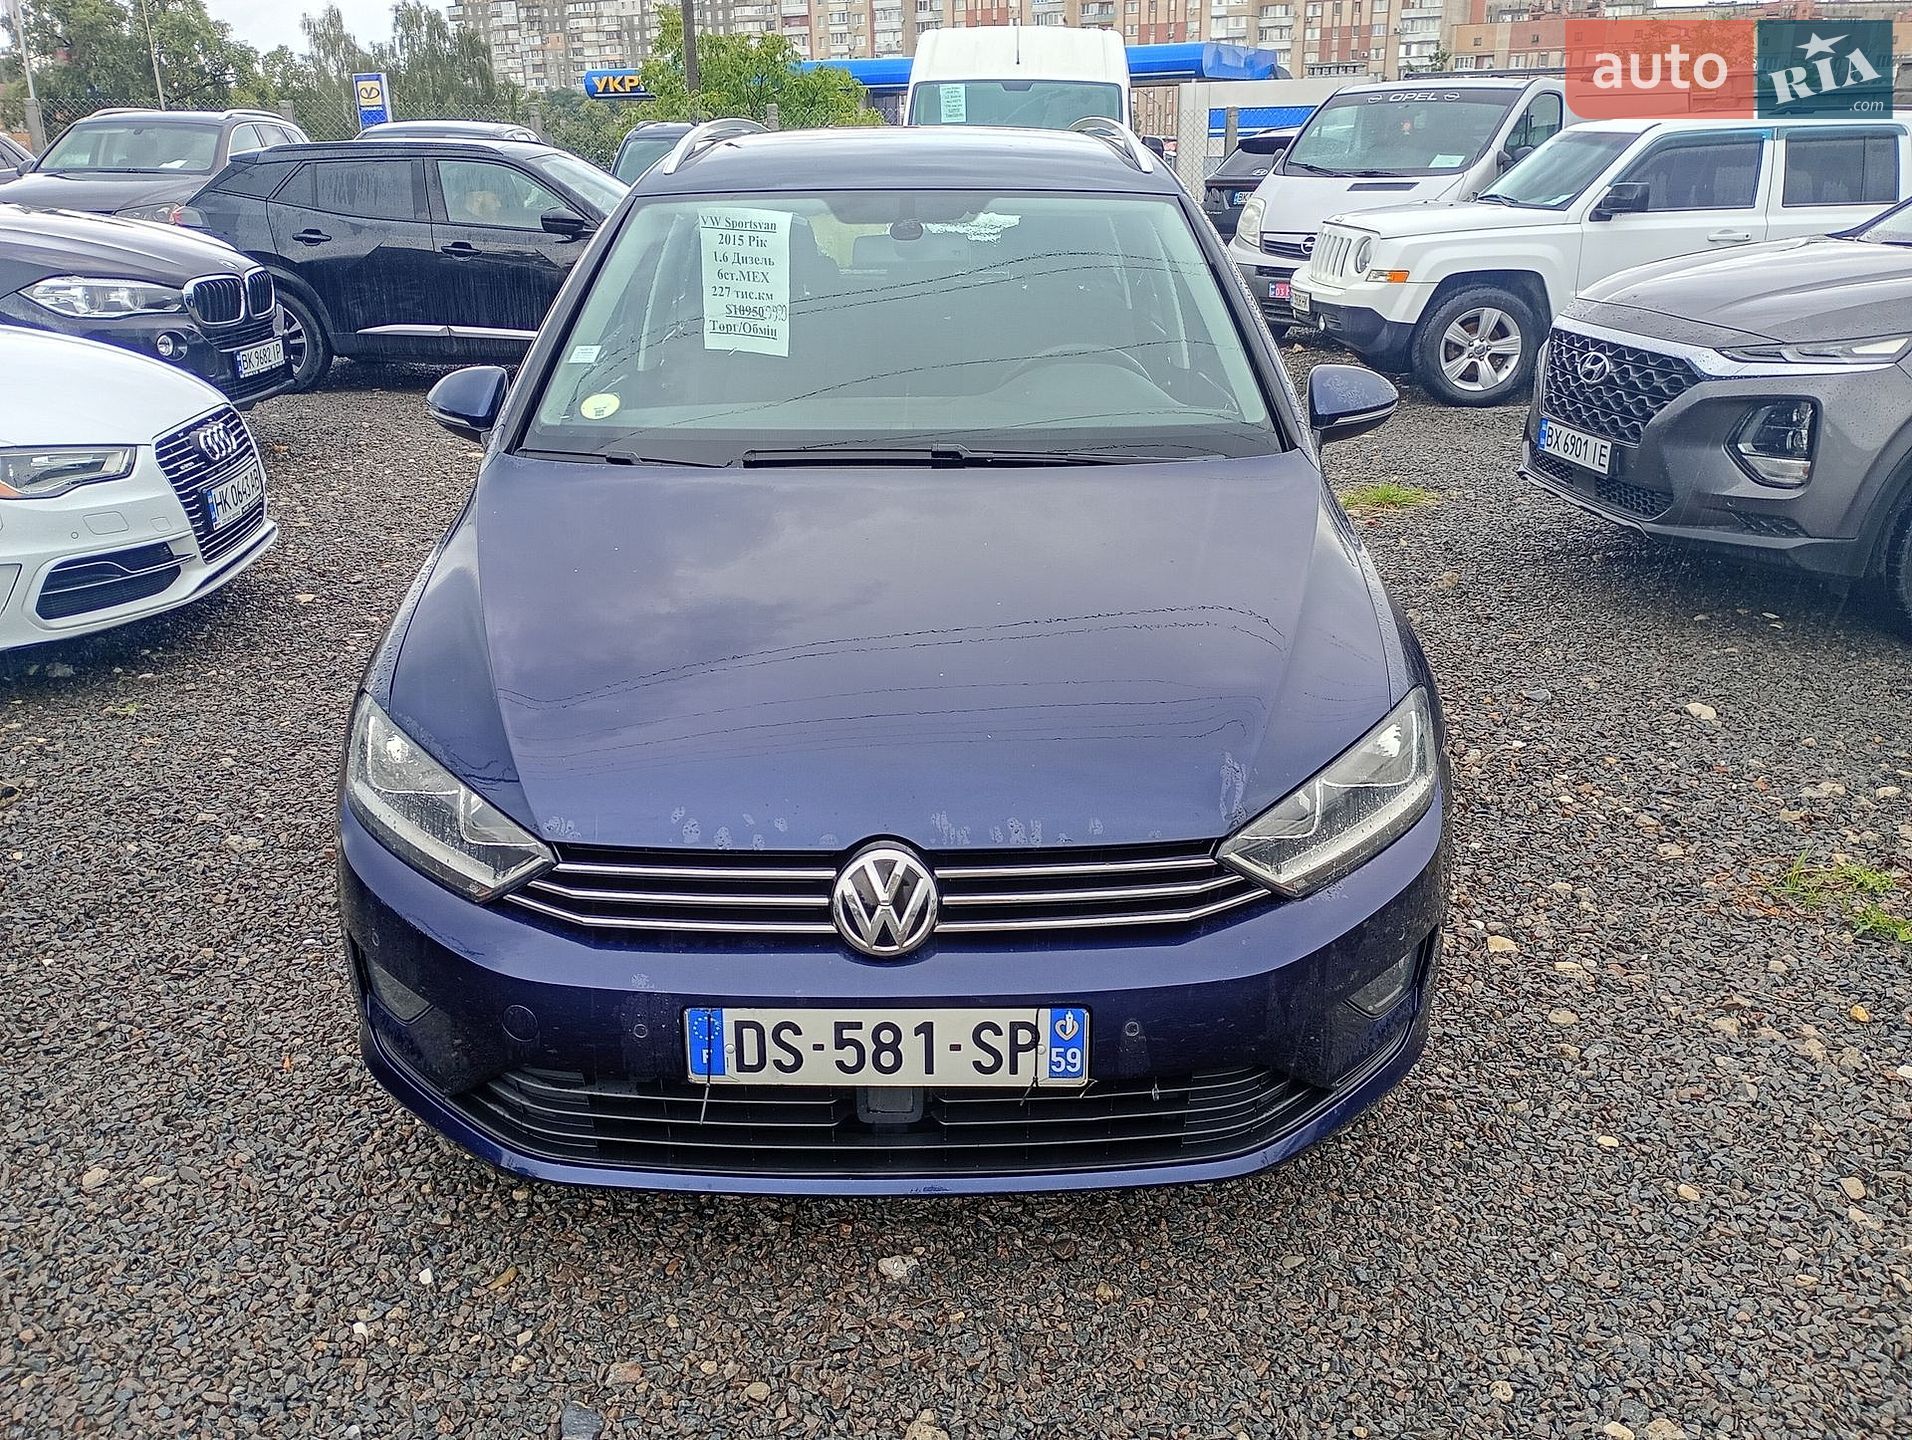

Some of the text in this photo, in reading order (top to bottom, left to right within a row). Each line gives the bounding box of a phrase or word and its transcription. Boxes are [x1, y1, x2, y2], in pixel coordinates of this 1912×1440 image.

[1388, 92, 1438, 102] OPEL
[700, 215, 777, 231] VW Sportsvan
[718, 233, 768, 248] 2015 Рік
[713, 251, 775, 266] 1.6 Дизель
[717, 268, 770, 283] 6ст.МЕХ
[711, 286, 774, 301] 227 тис.км
[709, 320, 777, 337] Торг/Обмін
[241, 351, 255, 370] BK
[254, 346, 272, 367] 9682
[272, 343, 281, 361] IP
[1546, 426, 1608, 468] BX 6901 IE
[213, 487, 232, 517] HK
[230, 474, 251, 507] 0643
[733, 1020, 1041, 1076] DS-581-SP
[1050, 1047, 1082, 1074] 59
